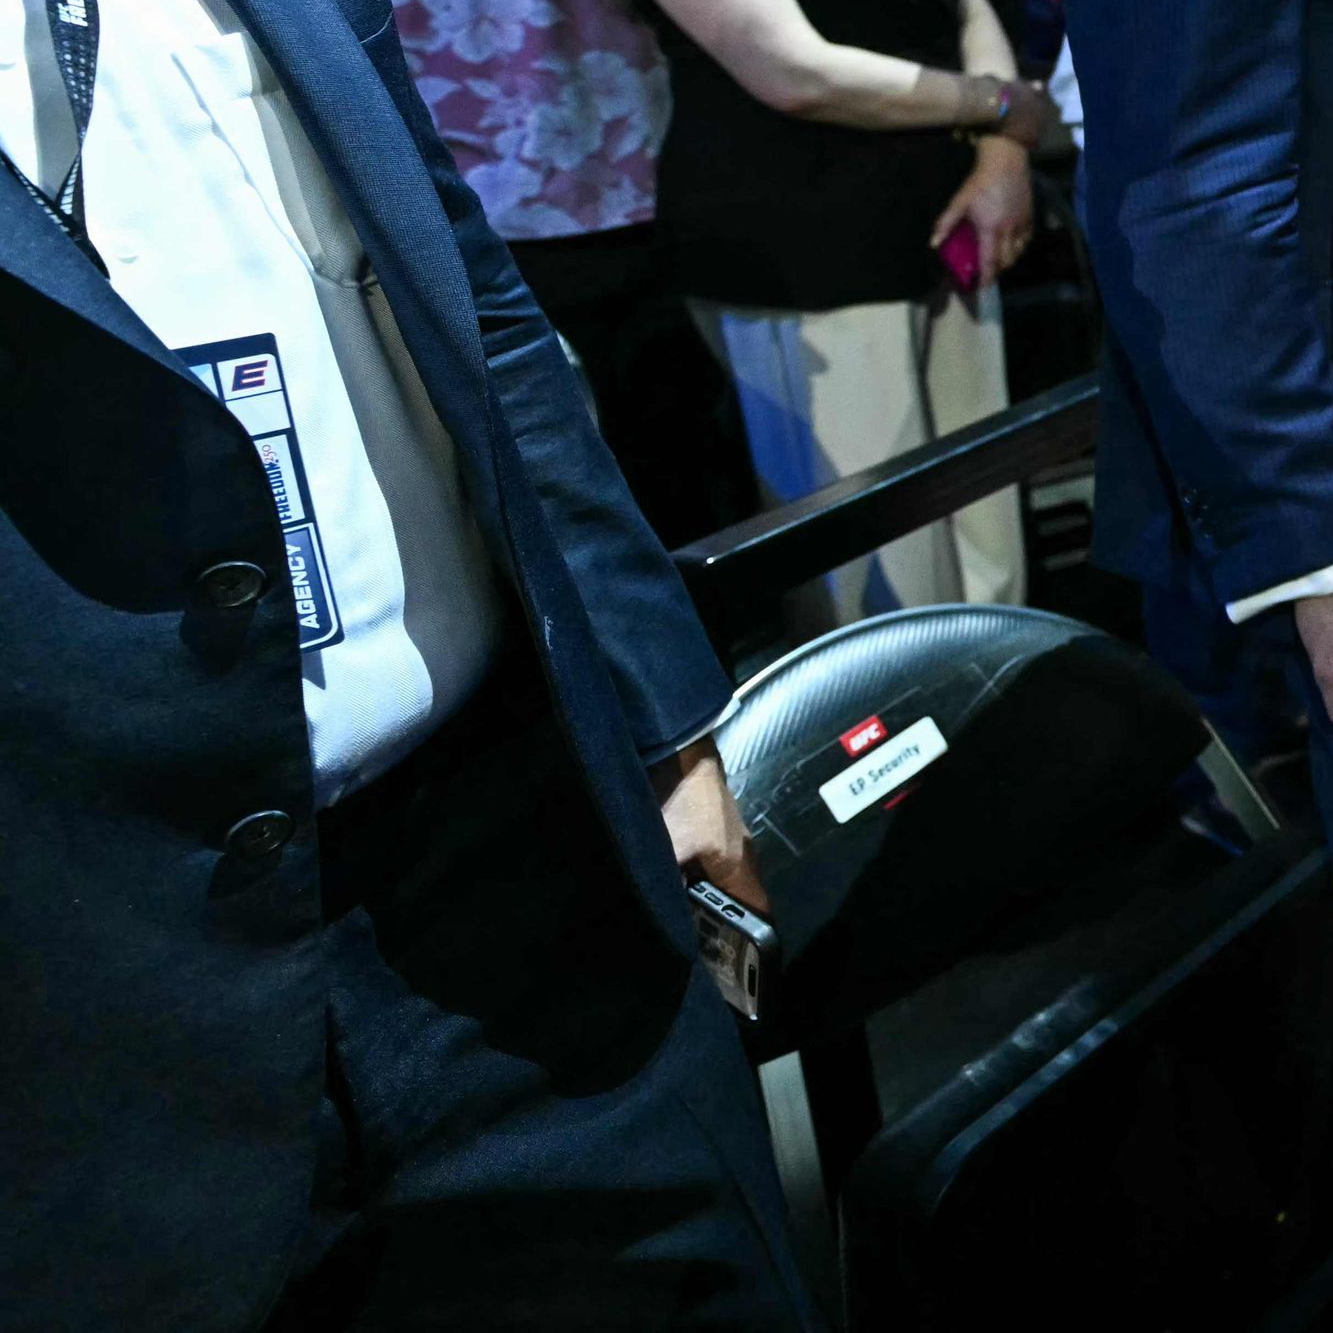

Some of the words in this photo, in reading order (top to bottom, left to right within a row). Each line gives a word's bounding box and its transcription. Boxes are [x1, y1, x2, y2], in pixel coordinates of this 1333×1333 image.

[286, 544, 320, 629] AGENCY
[848, 779, 867, 796] EP
[868, 744, 922, 782] Security
